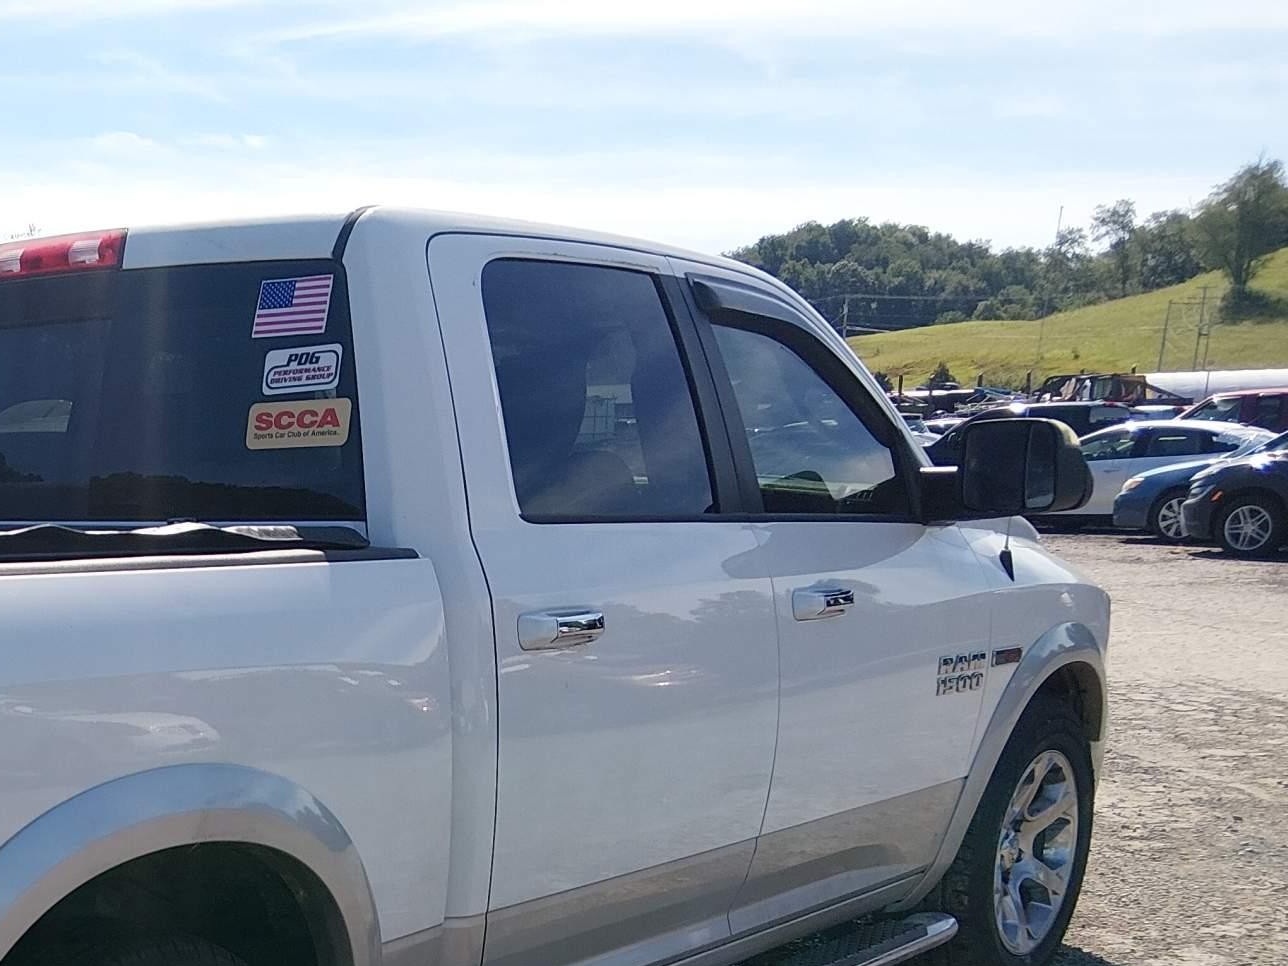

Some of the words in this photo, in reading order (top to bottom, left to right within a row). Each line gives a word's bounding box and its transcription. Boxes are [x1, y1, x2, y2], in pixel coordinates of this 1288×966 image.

[287, 352, 320, 366] PDG
[270, 376, 302, 384] DRIVING
[305, 372, 334, 381] GROUP
[273, 366, 331, 377] PERFORMANCE
[254, 408, 340, 431] SCCA
[254, 432, 273, 440] Sports
[275, 431, 286, 439] Car
[287, 430, 302, 438] Club
[937, 652, 986, 675] RAM
[936, 672, 984, 696] 1500
